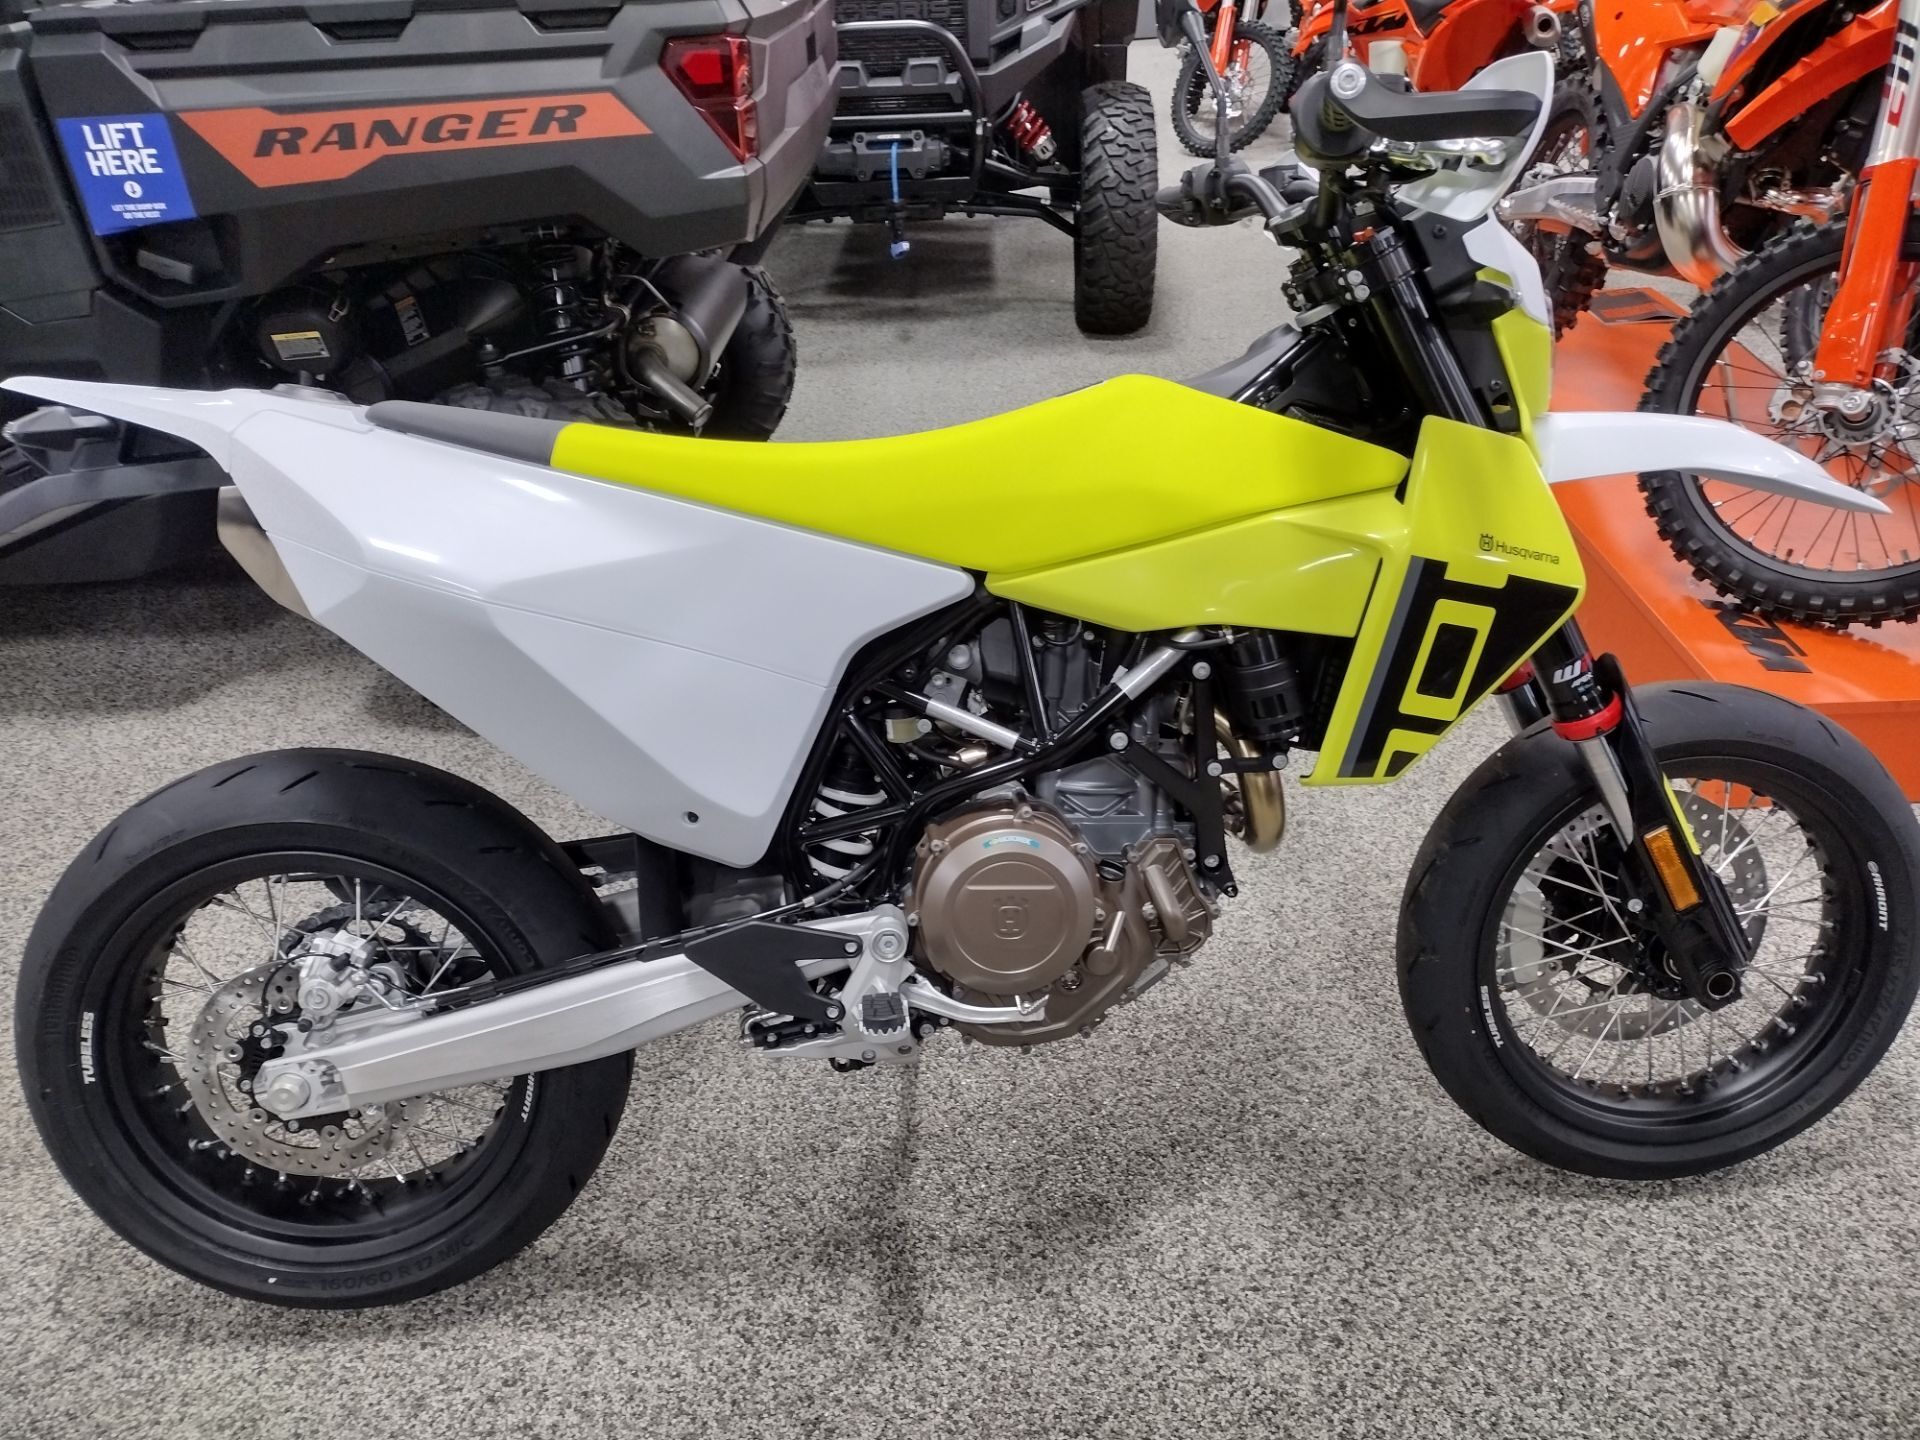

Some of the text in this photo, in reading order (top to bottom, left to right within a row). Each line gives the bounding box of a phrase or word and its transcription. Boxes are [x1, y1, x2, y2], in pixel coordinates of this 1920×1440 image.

[81, 122, 144, 150] LIFT
[253, 104, 587, 158] RANGER
[85, 148, 164, 176] HERE
[1495, 540, 1560, 565] Husqvarna
[1480, 985, 1504, 1048] TUBELESS
[80, 1011, 96, 1085] TUBELESS
[320, 1270, 393, 1290] 160/60
